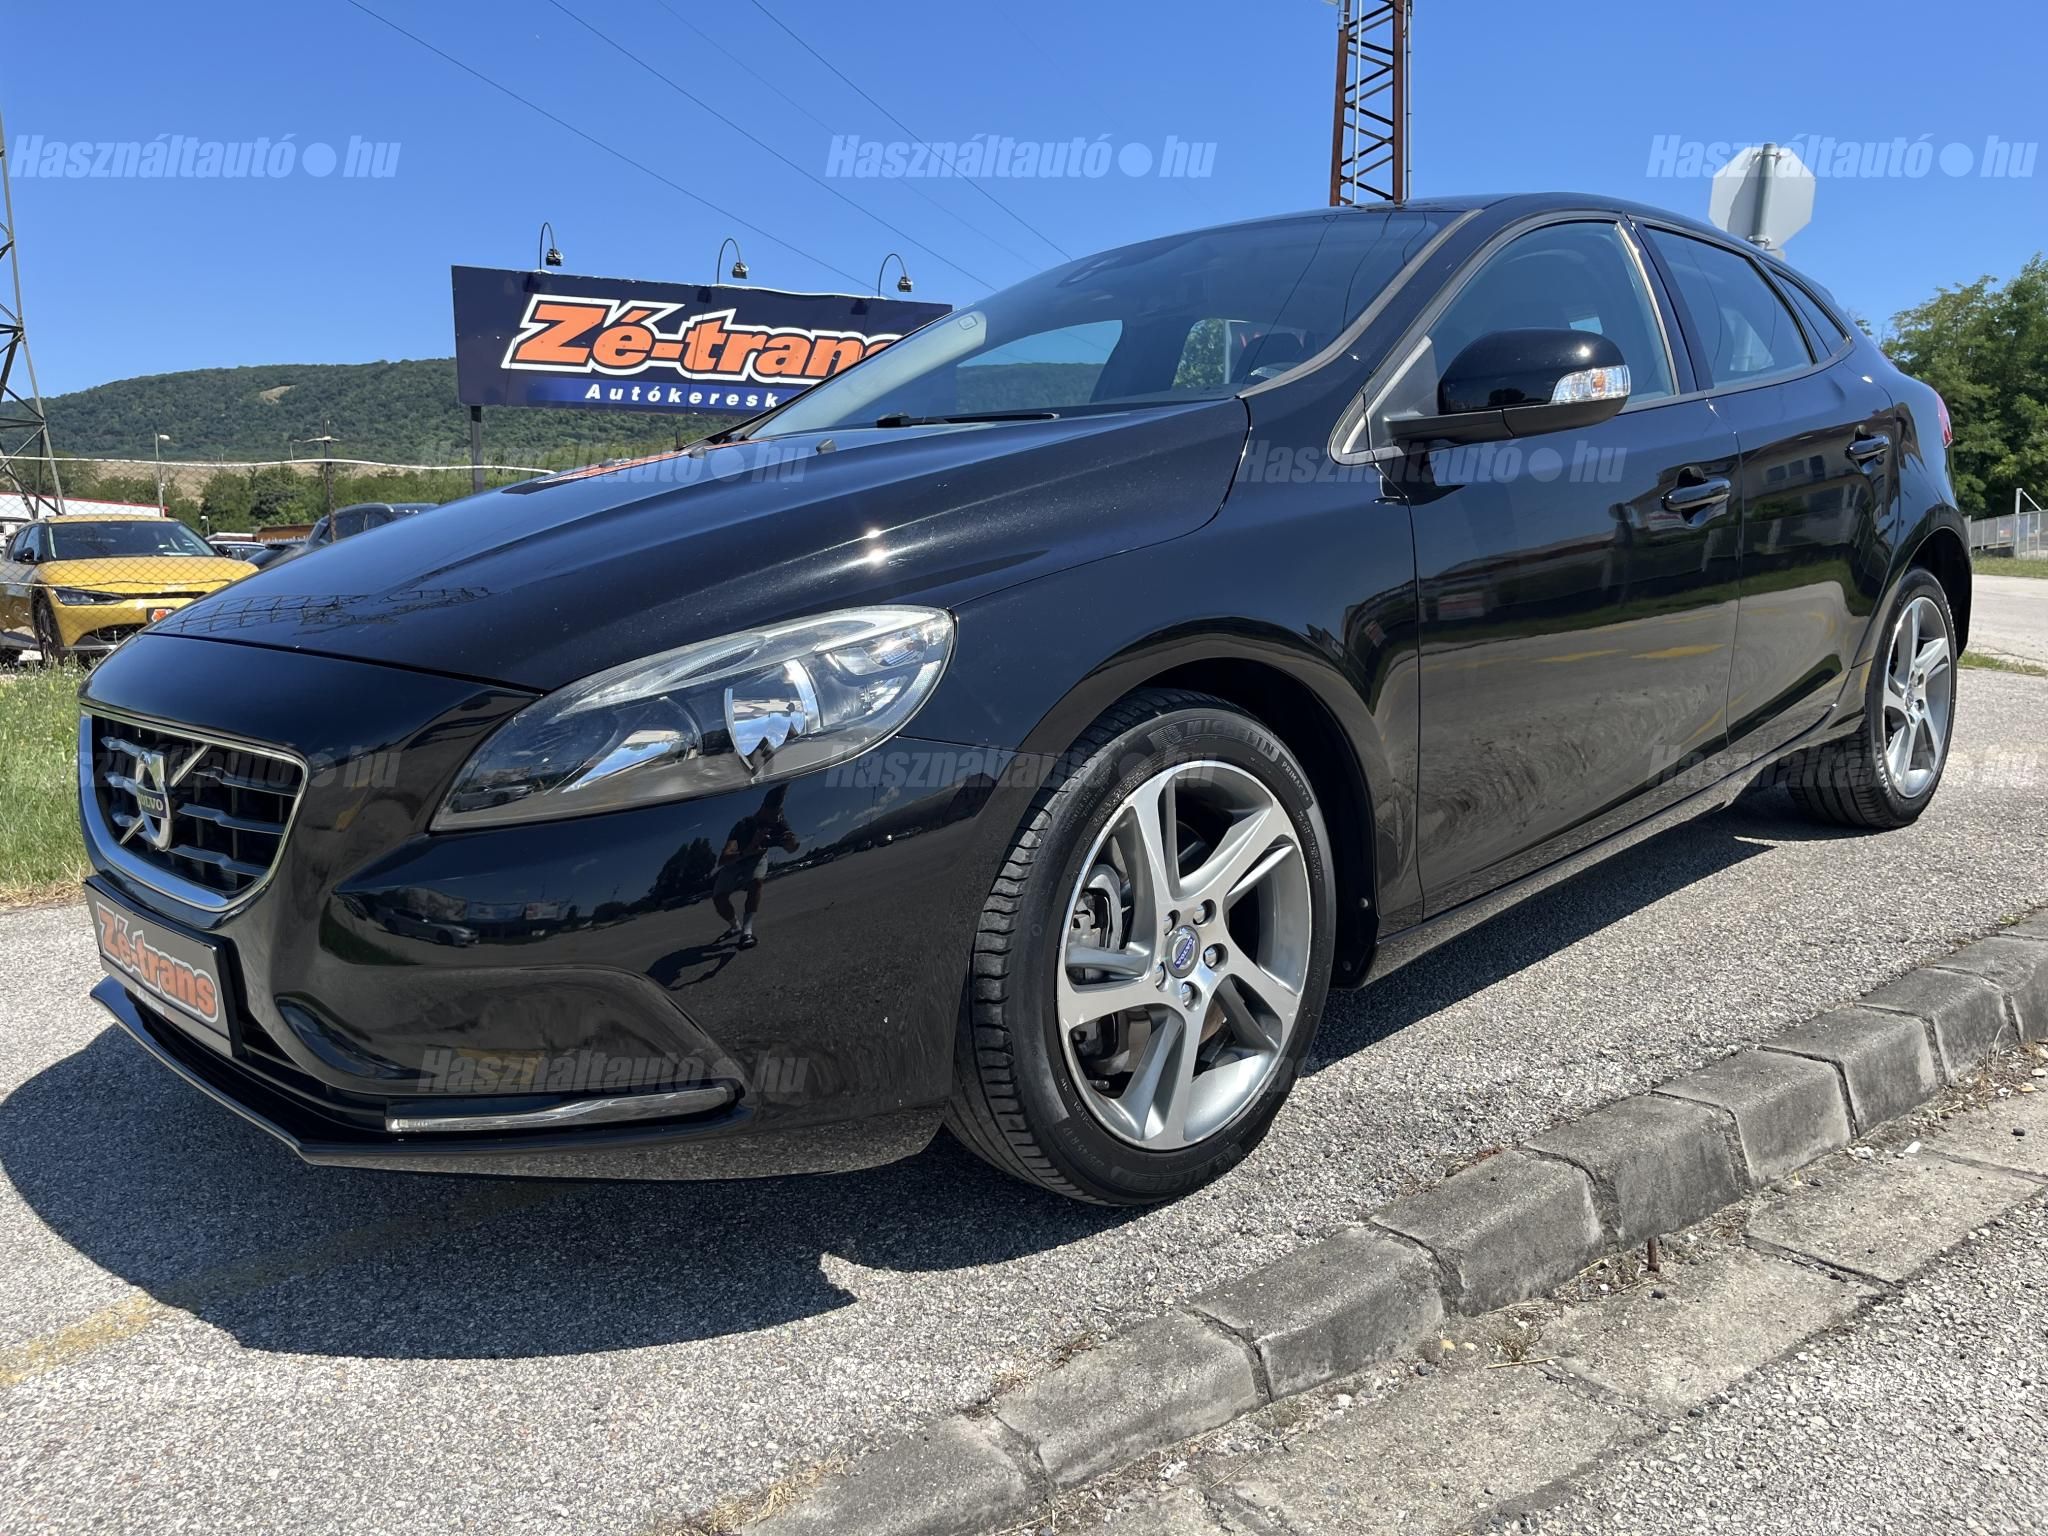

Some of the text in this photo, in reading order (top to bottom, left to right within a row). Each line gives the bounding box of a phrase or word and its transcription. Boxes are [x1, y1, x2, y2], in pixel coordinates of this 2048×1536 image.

[503, 295, 903, 383] Zé-tran
[585, 384, 778, 408] Autókeresk
[1281, 761, 1307, 796] PRIMACY
[137, 793, 164, 812] VOLVO
[97, 902, 219, 1022] Zé-trans
[1176, 937, 1194, 965] VOLVO
